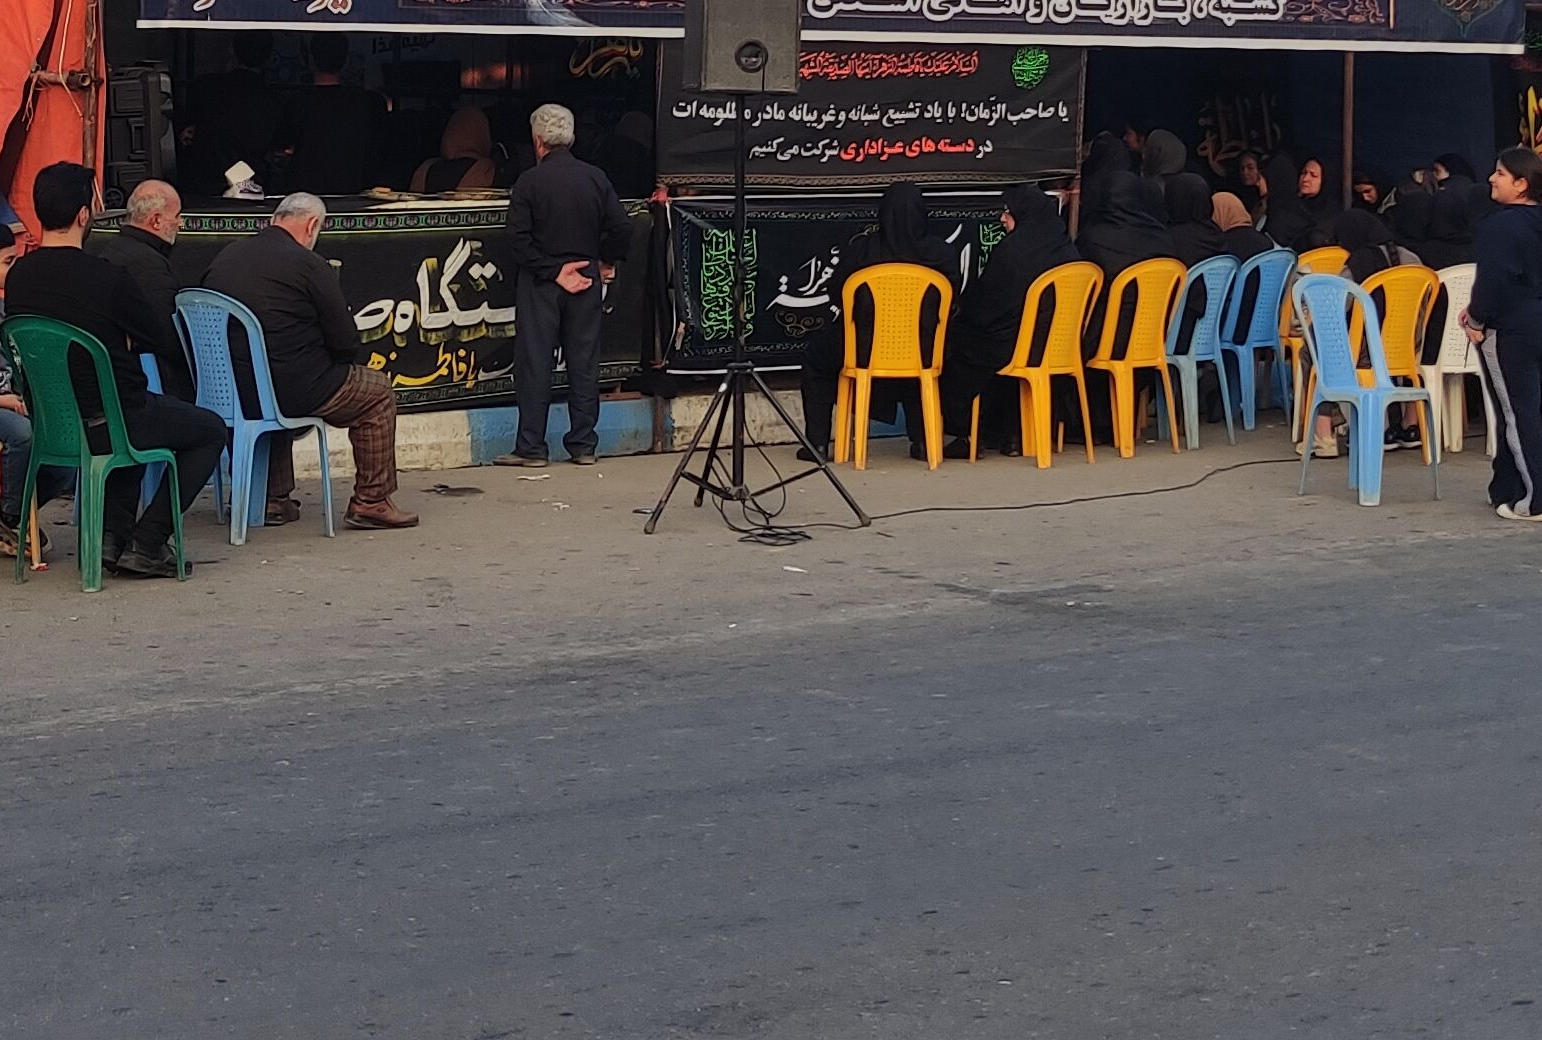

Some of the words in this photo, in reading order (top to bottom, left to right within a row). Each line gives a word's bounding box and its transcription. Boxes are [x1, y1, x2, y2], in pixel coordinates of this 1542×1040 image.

[672, 99, 698, 119] ات
[752, 101, 786, 127] مادر
[788, 102, 837, 130] غریبانه
[835, 110, 847, 129] و
[848, 102, 881, 127] شبانه
[882, 101, 922, 128] تشییع
[923, 101, 943, 123] یاد
[947, 101, 957, 124] با
[1007, 101, 1056, 126] صاحب
[1057, 101, 1070, 123] یا
[800, 137, 841, 163] شرکت
[839, 136, 905, 162] عزاداری
[905, 135, 937, 158] های
[938, 137, 976, 153] دسته
[975, 138, 994, 159] در
